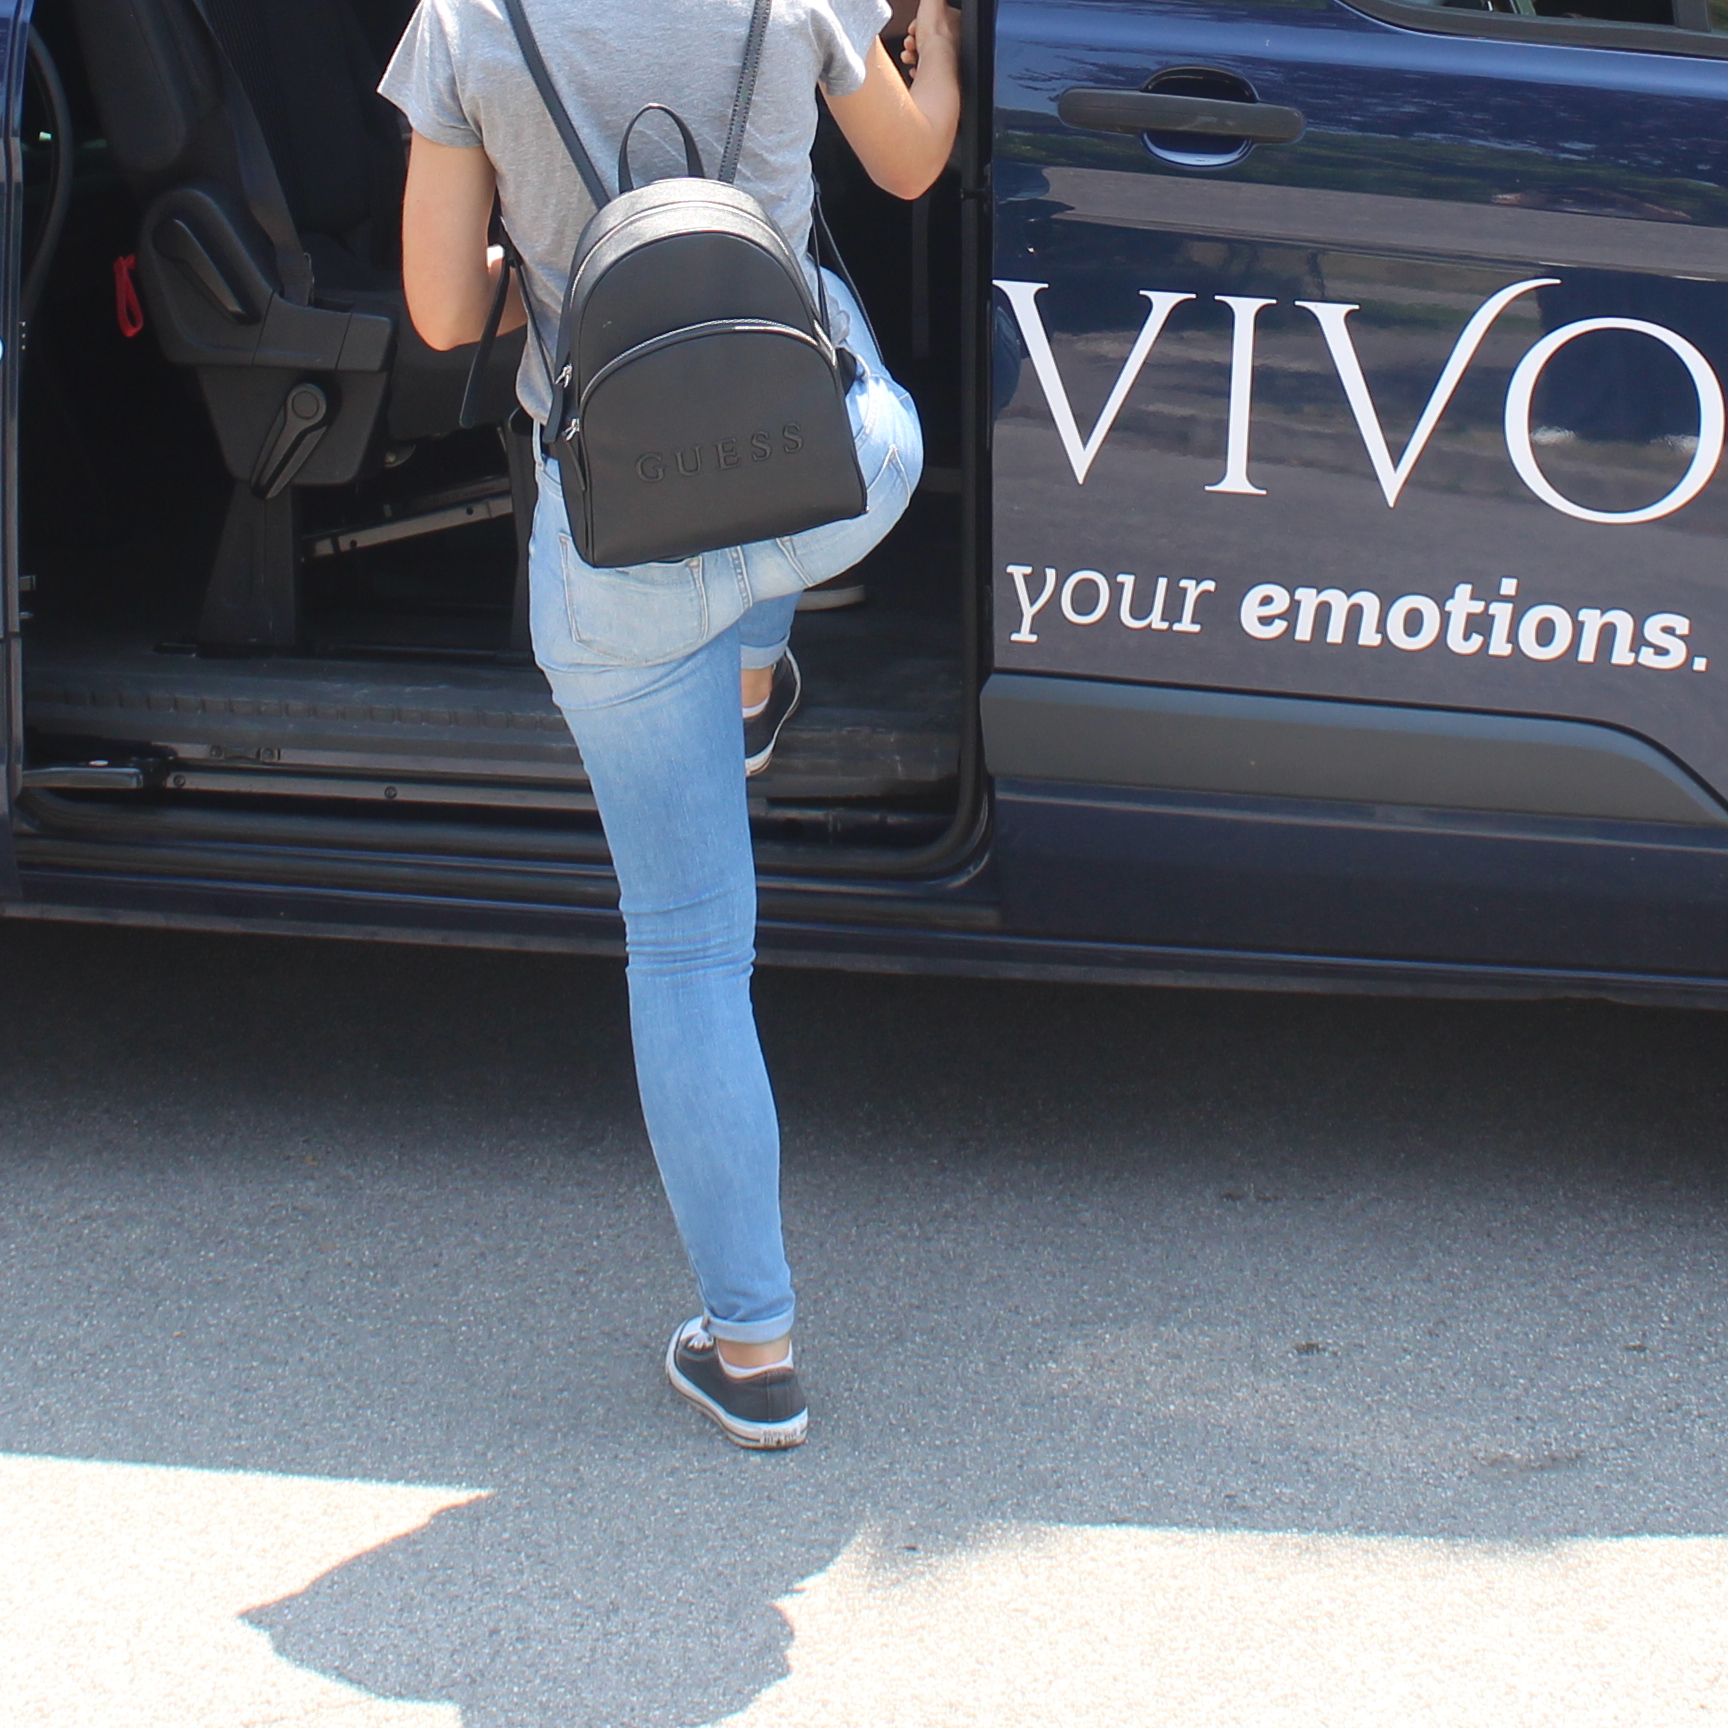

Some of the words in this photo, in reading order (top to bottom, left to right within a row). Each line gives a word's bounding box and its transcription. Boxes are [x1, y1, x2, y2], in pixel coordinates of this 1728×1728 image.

[634, 421, 806, 484] GUESS
[991, 277, 1727, 525] VIVO
[1005, 564, 1217, 643] your
[1239, 576, 1709, 672] emotions.
